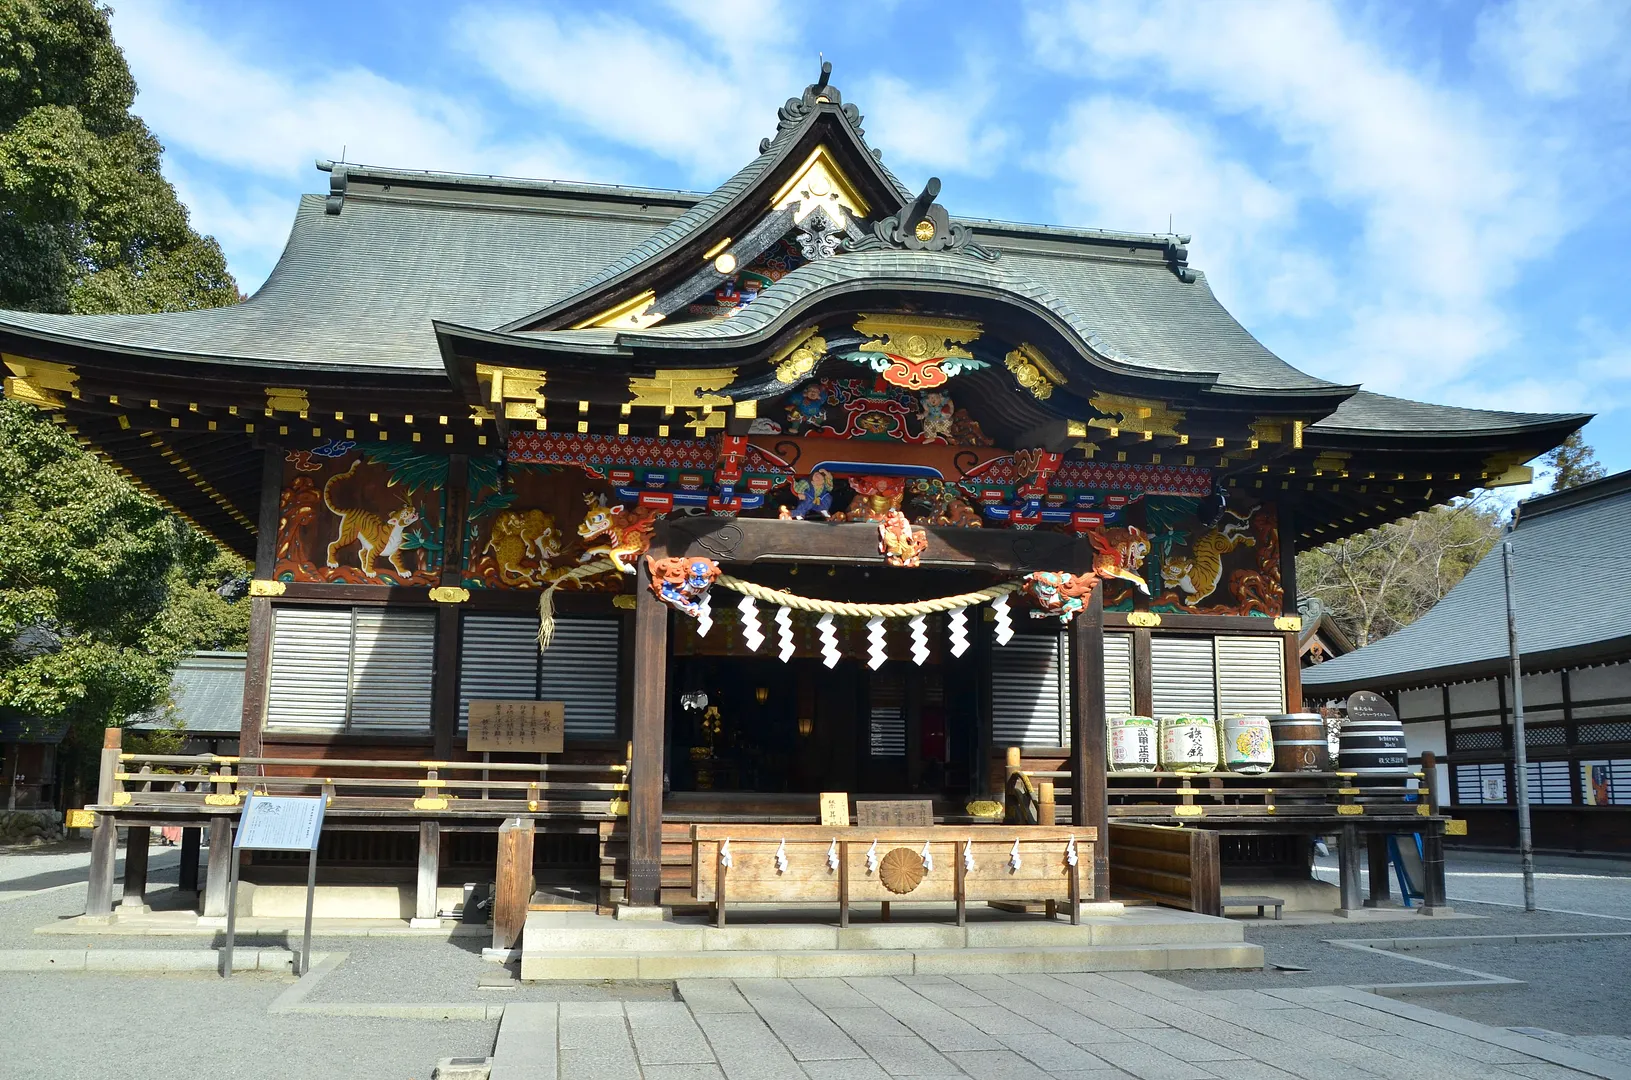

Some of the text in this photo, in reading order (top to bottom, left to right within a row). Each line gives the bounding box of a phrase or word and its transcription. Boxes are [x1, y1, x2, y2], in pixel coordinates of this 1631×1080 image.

[1137, 727, 1149, 763] 武甲正宗
[1184, 726, 1204, 763] 秩父錦
